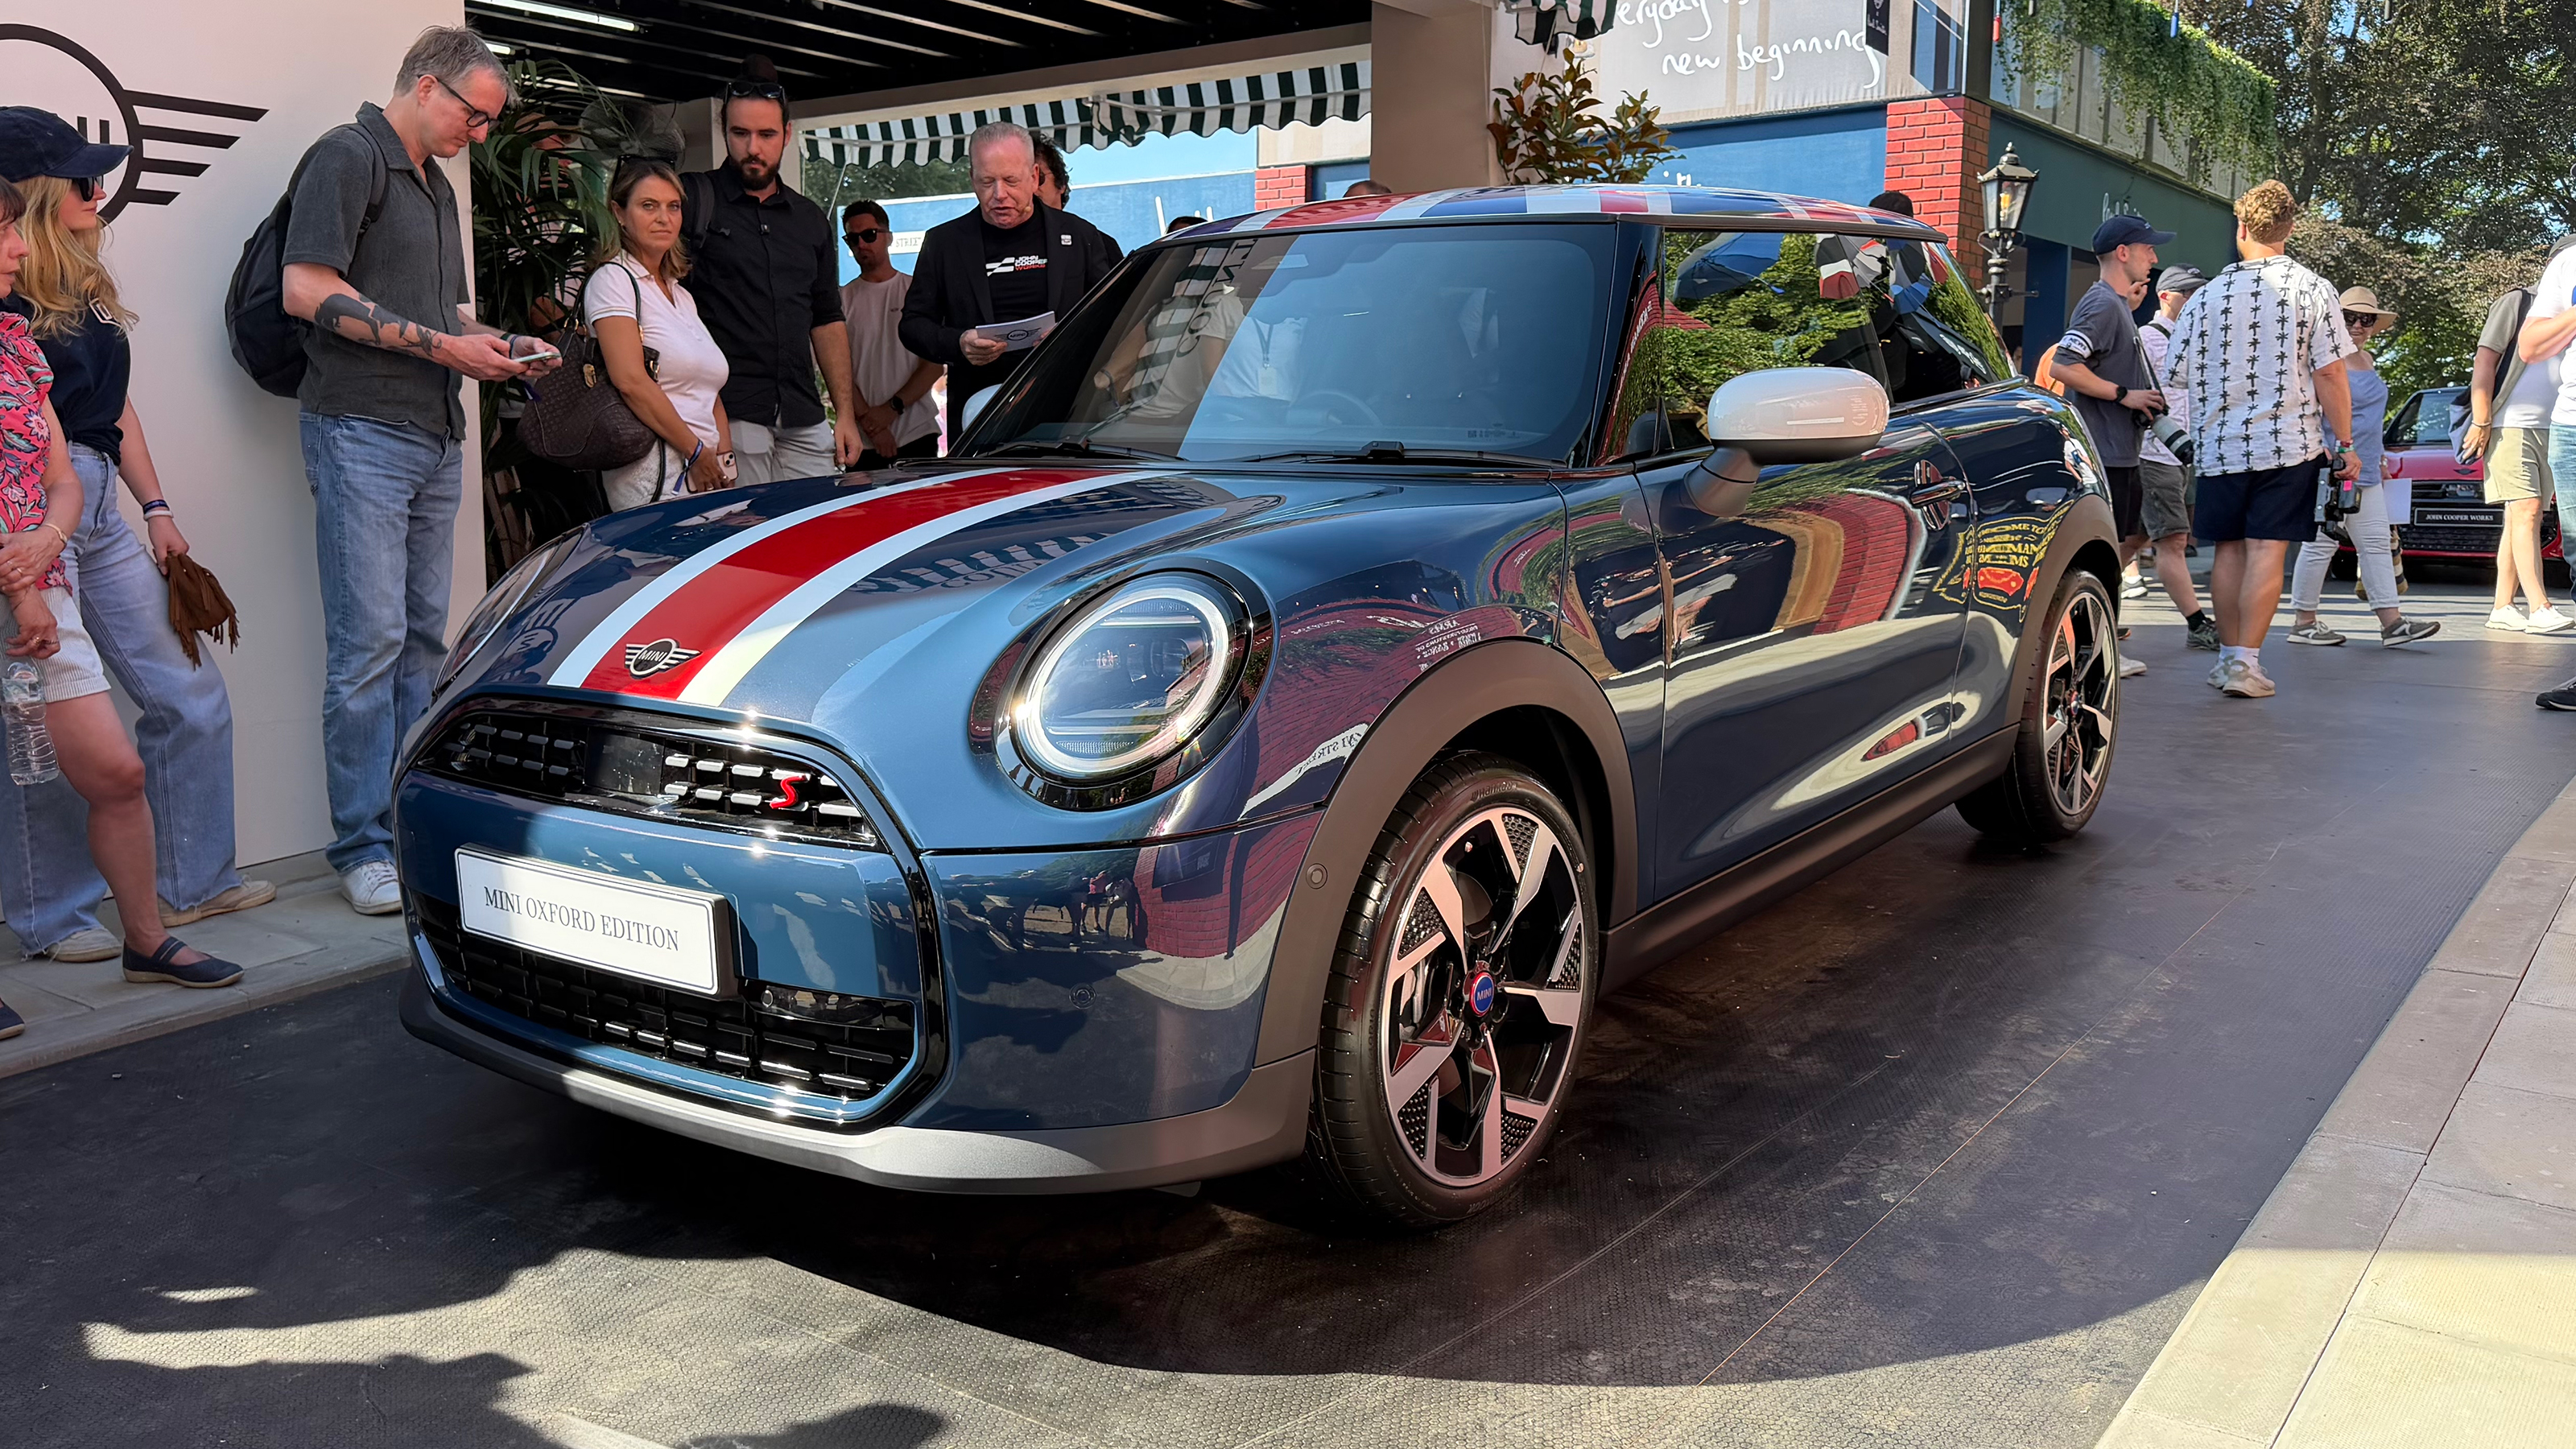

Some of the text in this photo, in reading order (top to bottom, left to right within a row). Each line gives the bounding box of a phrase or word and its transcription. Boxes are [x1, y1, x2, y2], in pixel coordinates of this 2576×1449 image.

[1617, 0, 1713, 48] eryday
[1662, 29, 1881, 89] new beginning
[638, 650, 668, 662] MINI
[769, 774, 809, 810] S
[484, 886, 679, 952] MINI OXFORD EDITION
[1476, 987, 1492, 1001] MINI
